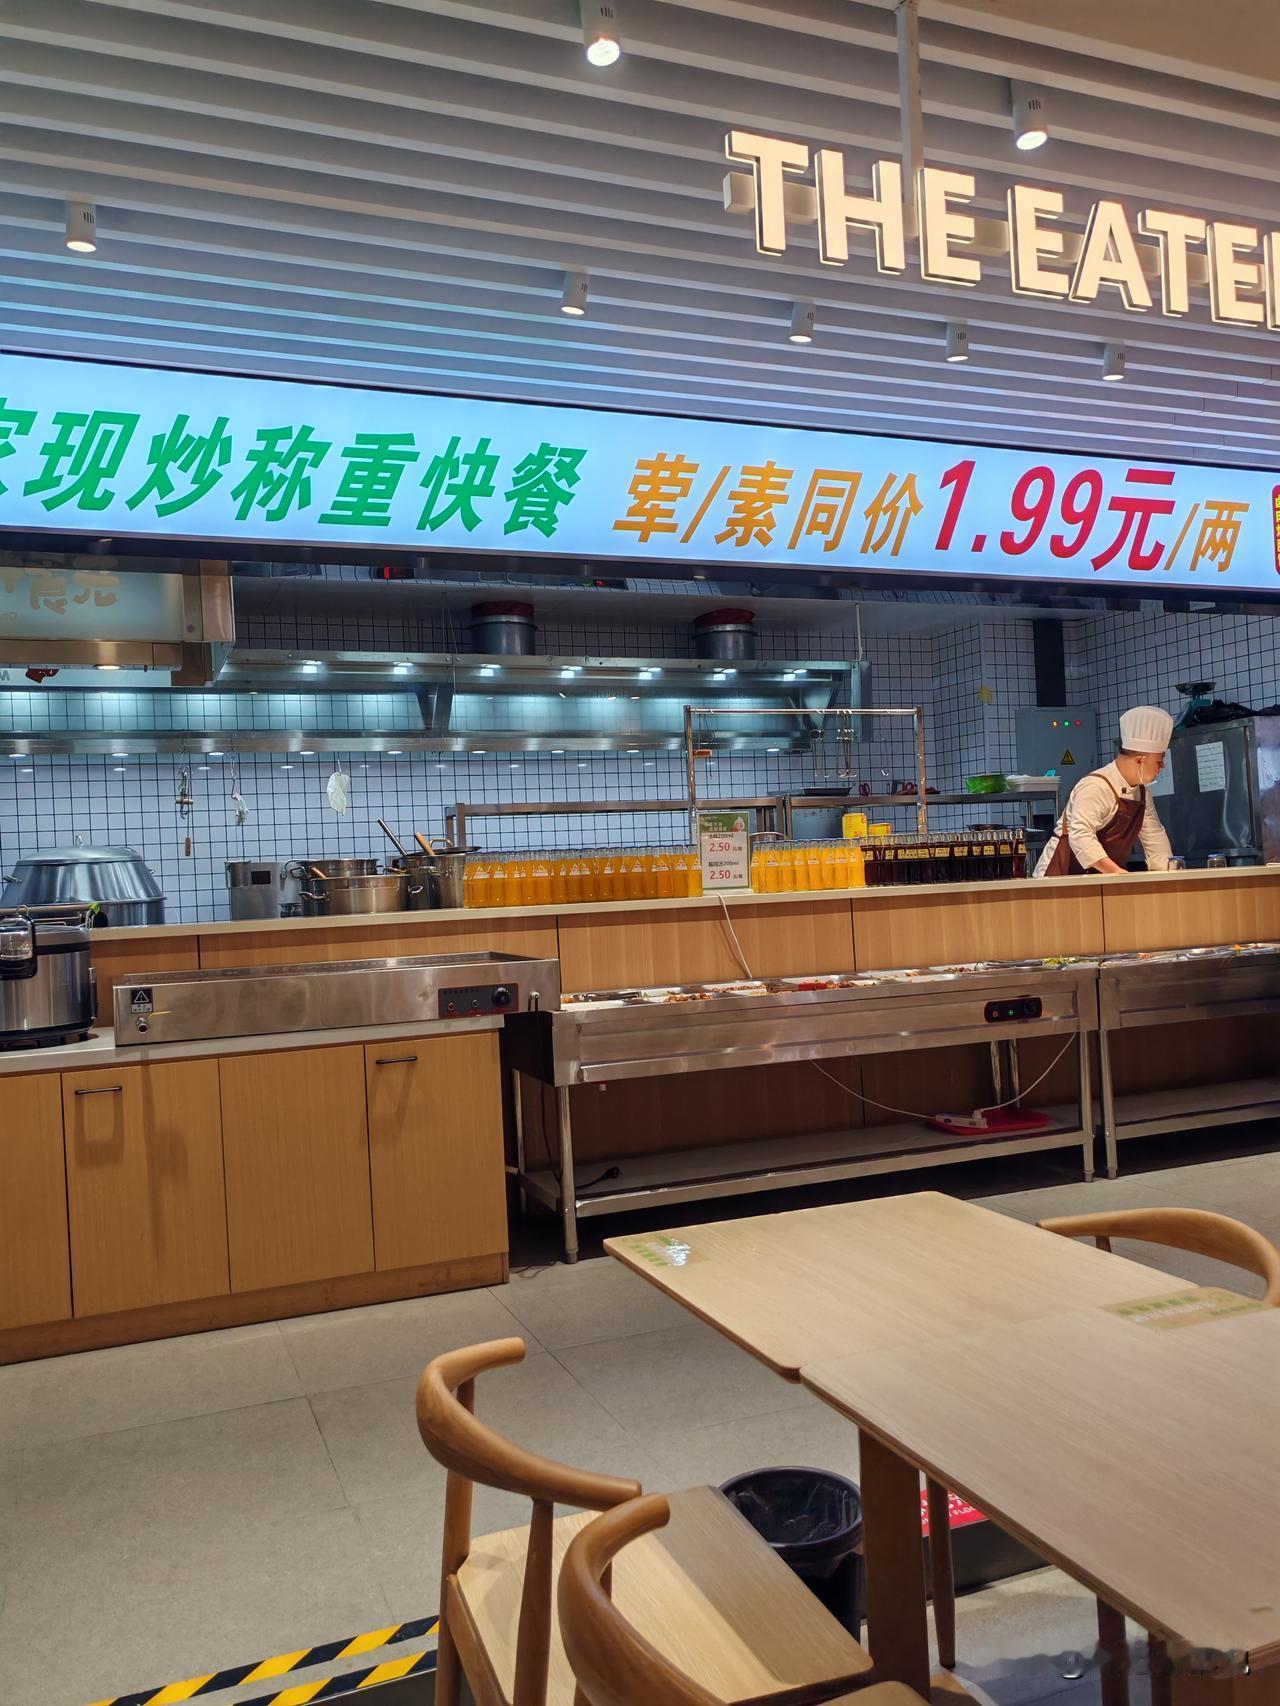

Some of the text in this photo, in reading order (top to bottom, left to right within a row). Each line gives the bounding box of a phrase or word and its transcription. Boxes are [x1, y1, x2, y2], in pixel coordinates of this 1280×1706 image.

[725, 130, 1280, 332] THE EATE
[709, 842, 730, 852] 2.50
[709, 870, 731, 880] 2.50
